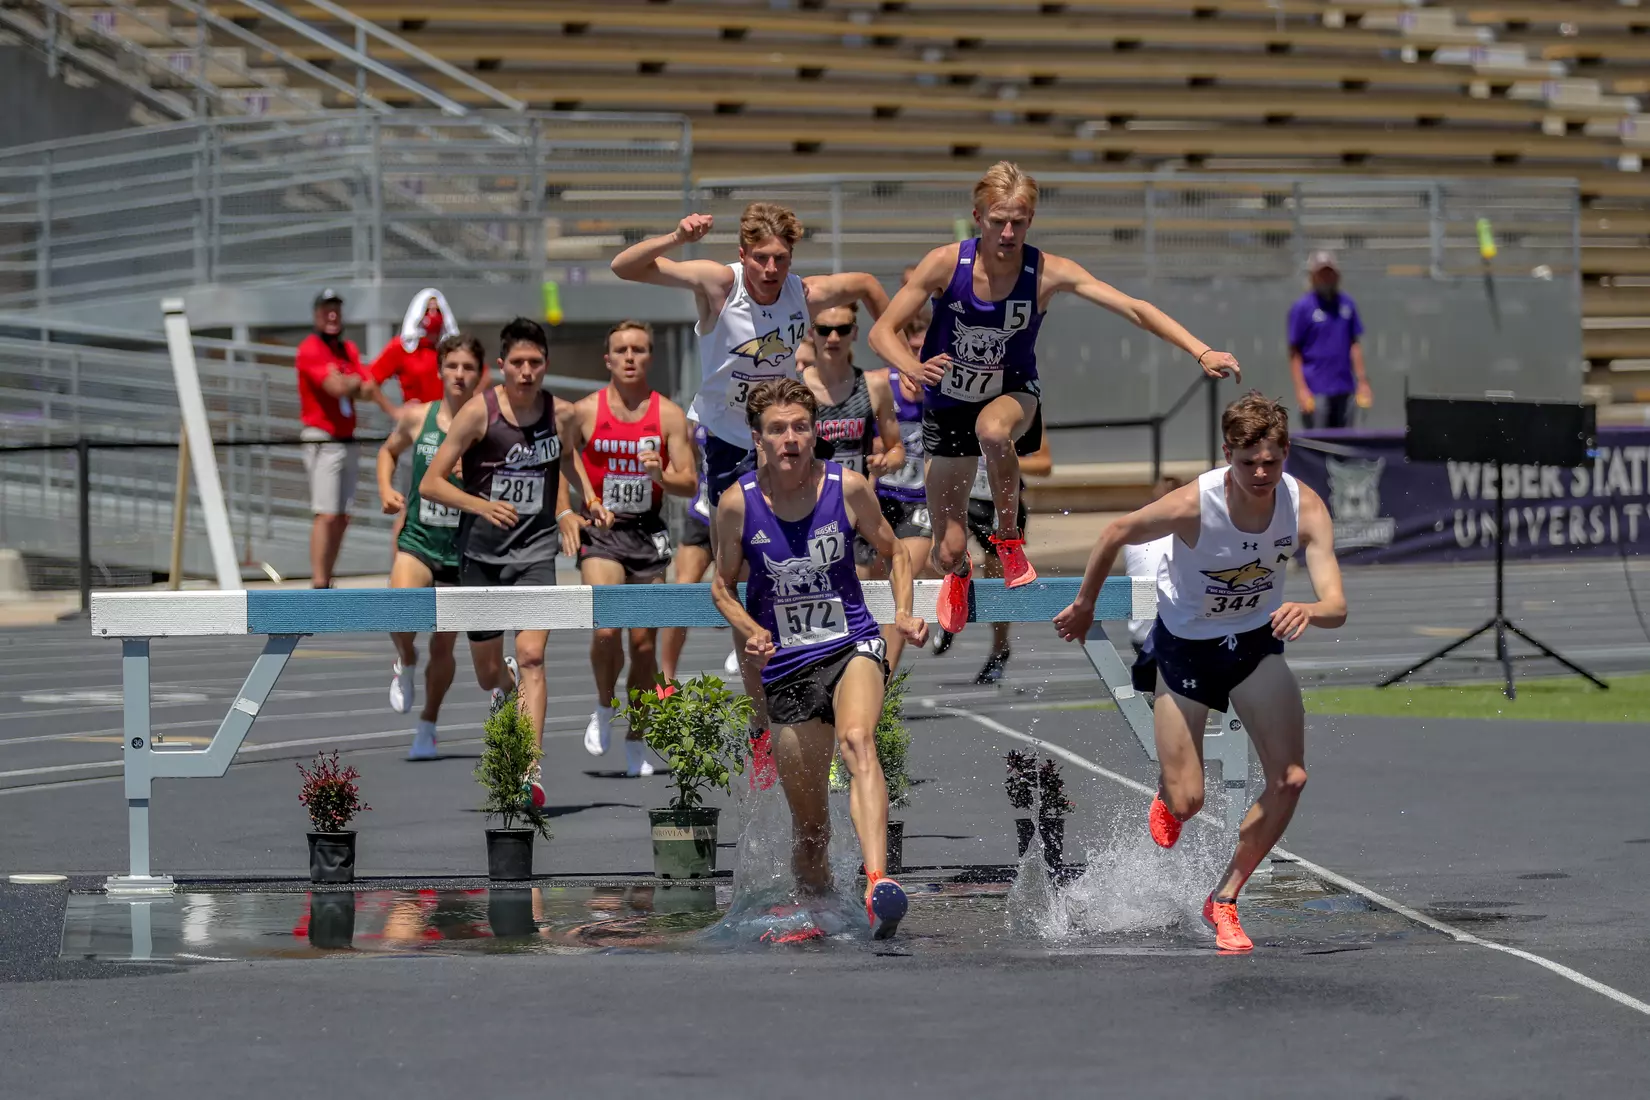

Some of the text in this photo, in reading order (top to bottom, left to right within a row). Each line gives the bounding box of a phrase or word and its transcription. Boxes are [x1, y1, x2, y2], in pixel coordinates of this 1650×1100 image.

[1010, 302, 1027, 329] 5
[788, 322, 805, 345] 14
[951, 364, 994, 394] 577
[541, 438, 557, 460] 10
[1446, 446, 1650, 499] WEBER STAT
[498, 478, 535, 503] 281
[610, 482, 645, 503] 499
[1453, 503, 1650, 548] UNIVERSIT
[815, 536, 841, 564] 12
[1211, 594, 1261, 613] 344
[785, 601, 837, 634] 572
